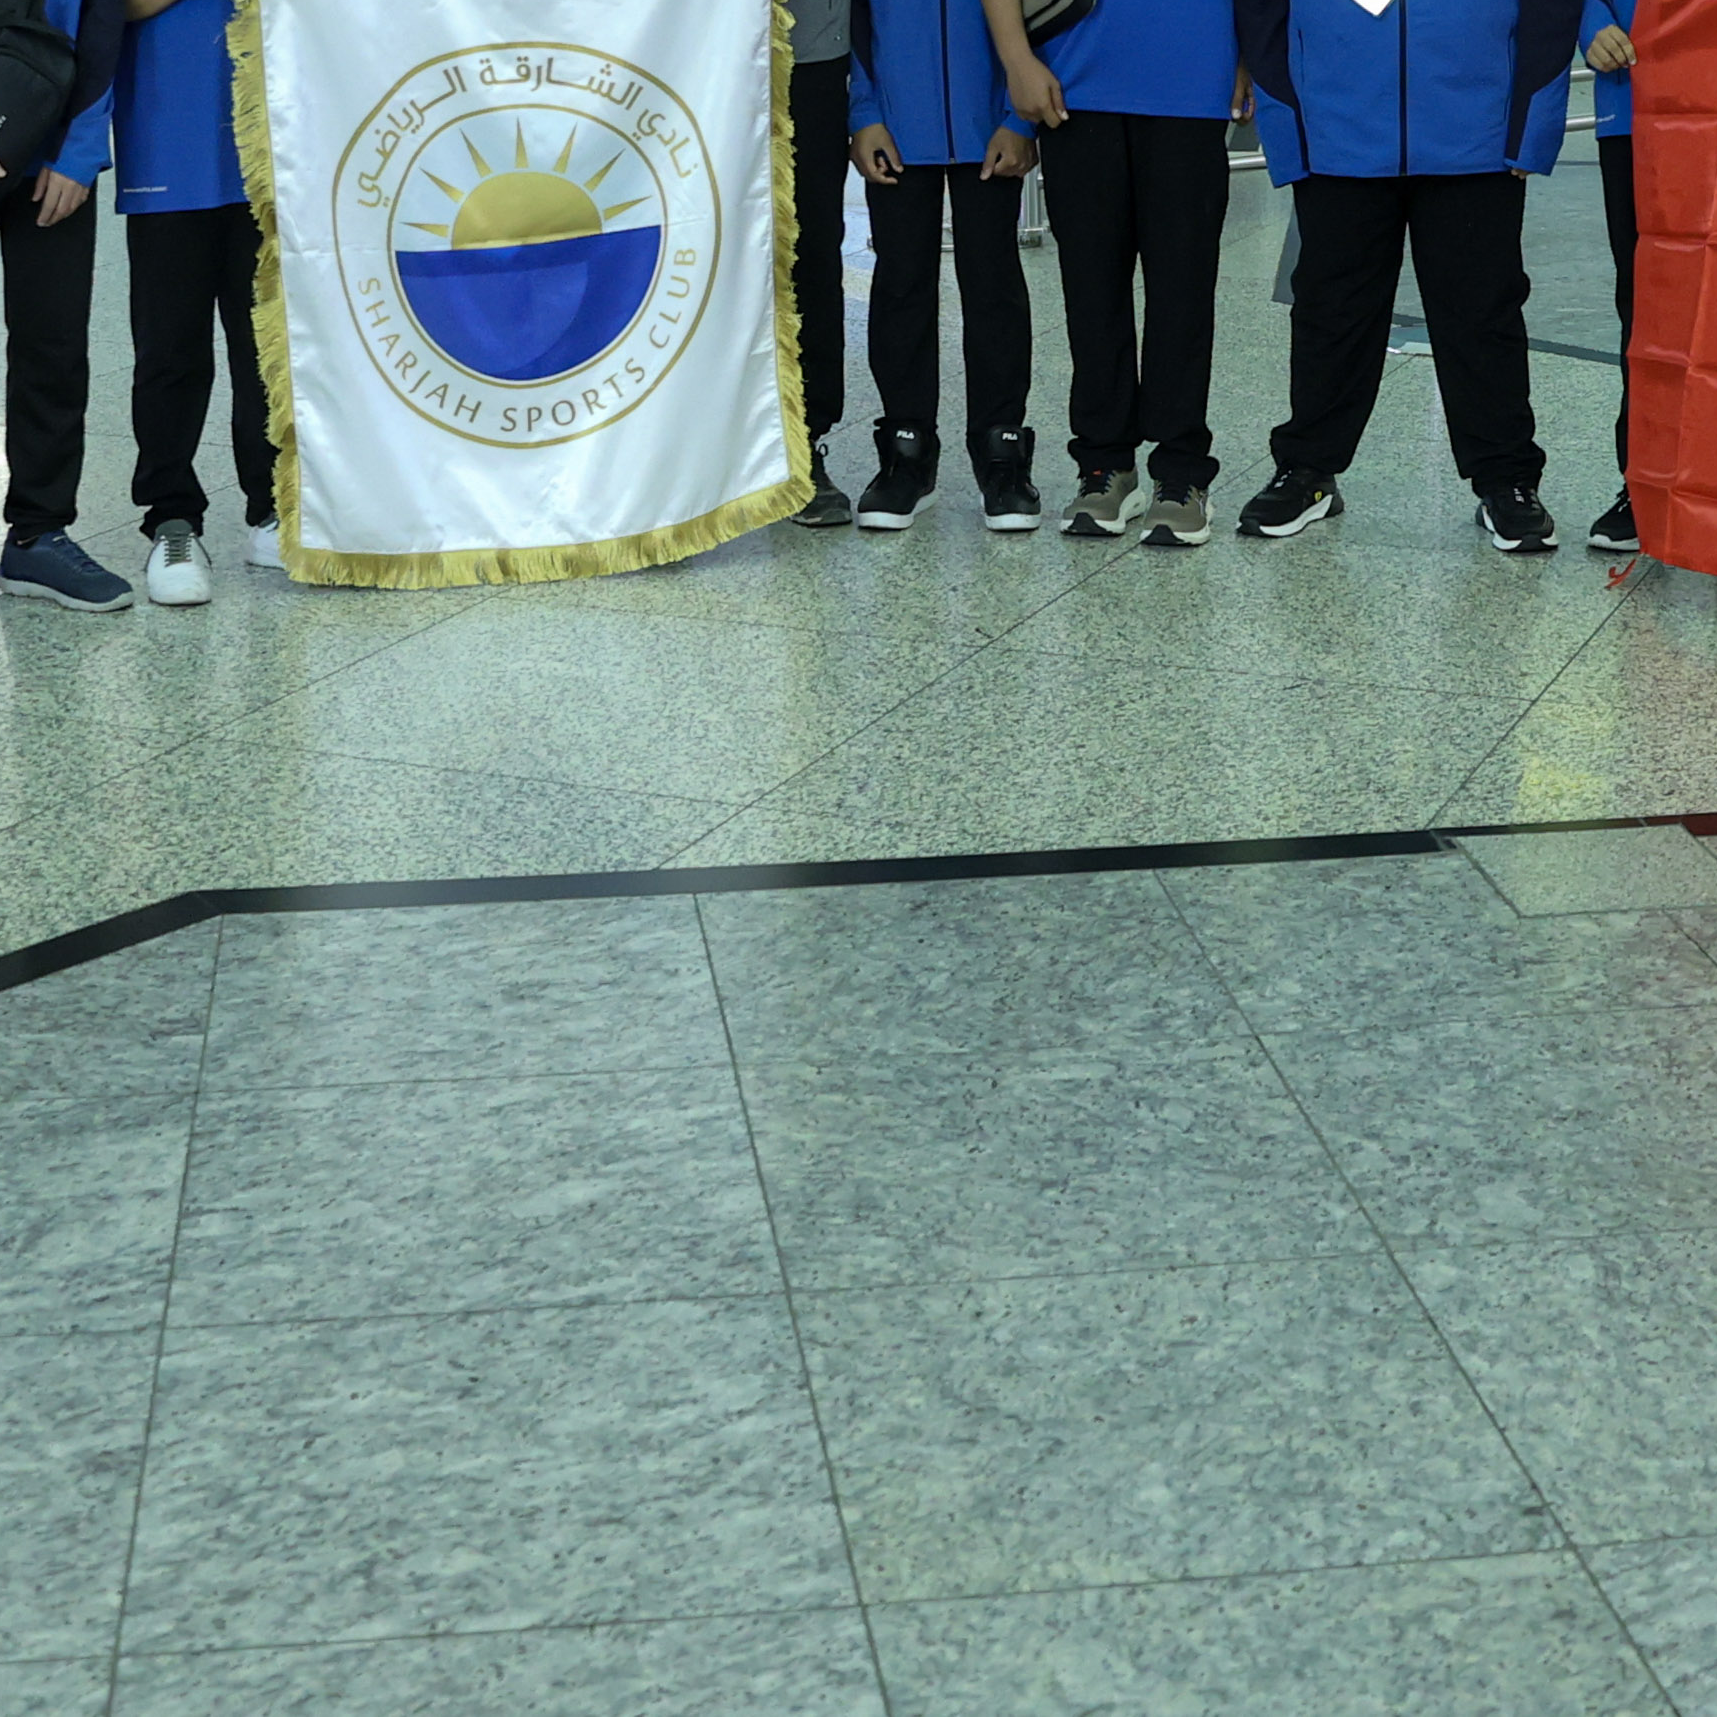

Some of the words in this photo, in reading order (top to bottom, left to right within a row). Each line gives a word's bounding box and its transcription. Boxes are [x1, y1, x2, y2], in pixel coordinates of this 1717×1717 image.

[478, 55, 644, 112] الشارقة
[357, 65, 468, 209] الرياضي
[636, 108, 698, 179] نادي
[358, 277, 482, 424] SHARJAH
[500, 357, 647, 433] SPORTS
[648, 247, 697, 349] CLUB
[896, 430, 915, 440] FILA
[1002, 432, 1018, 441] FILA
